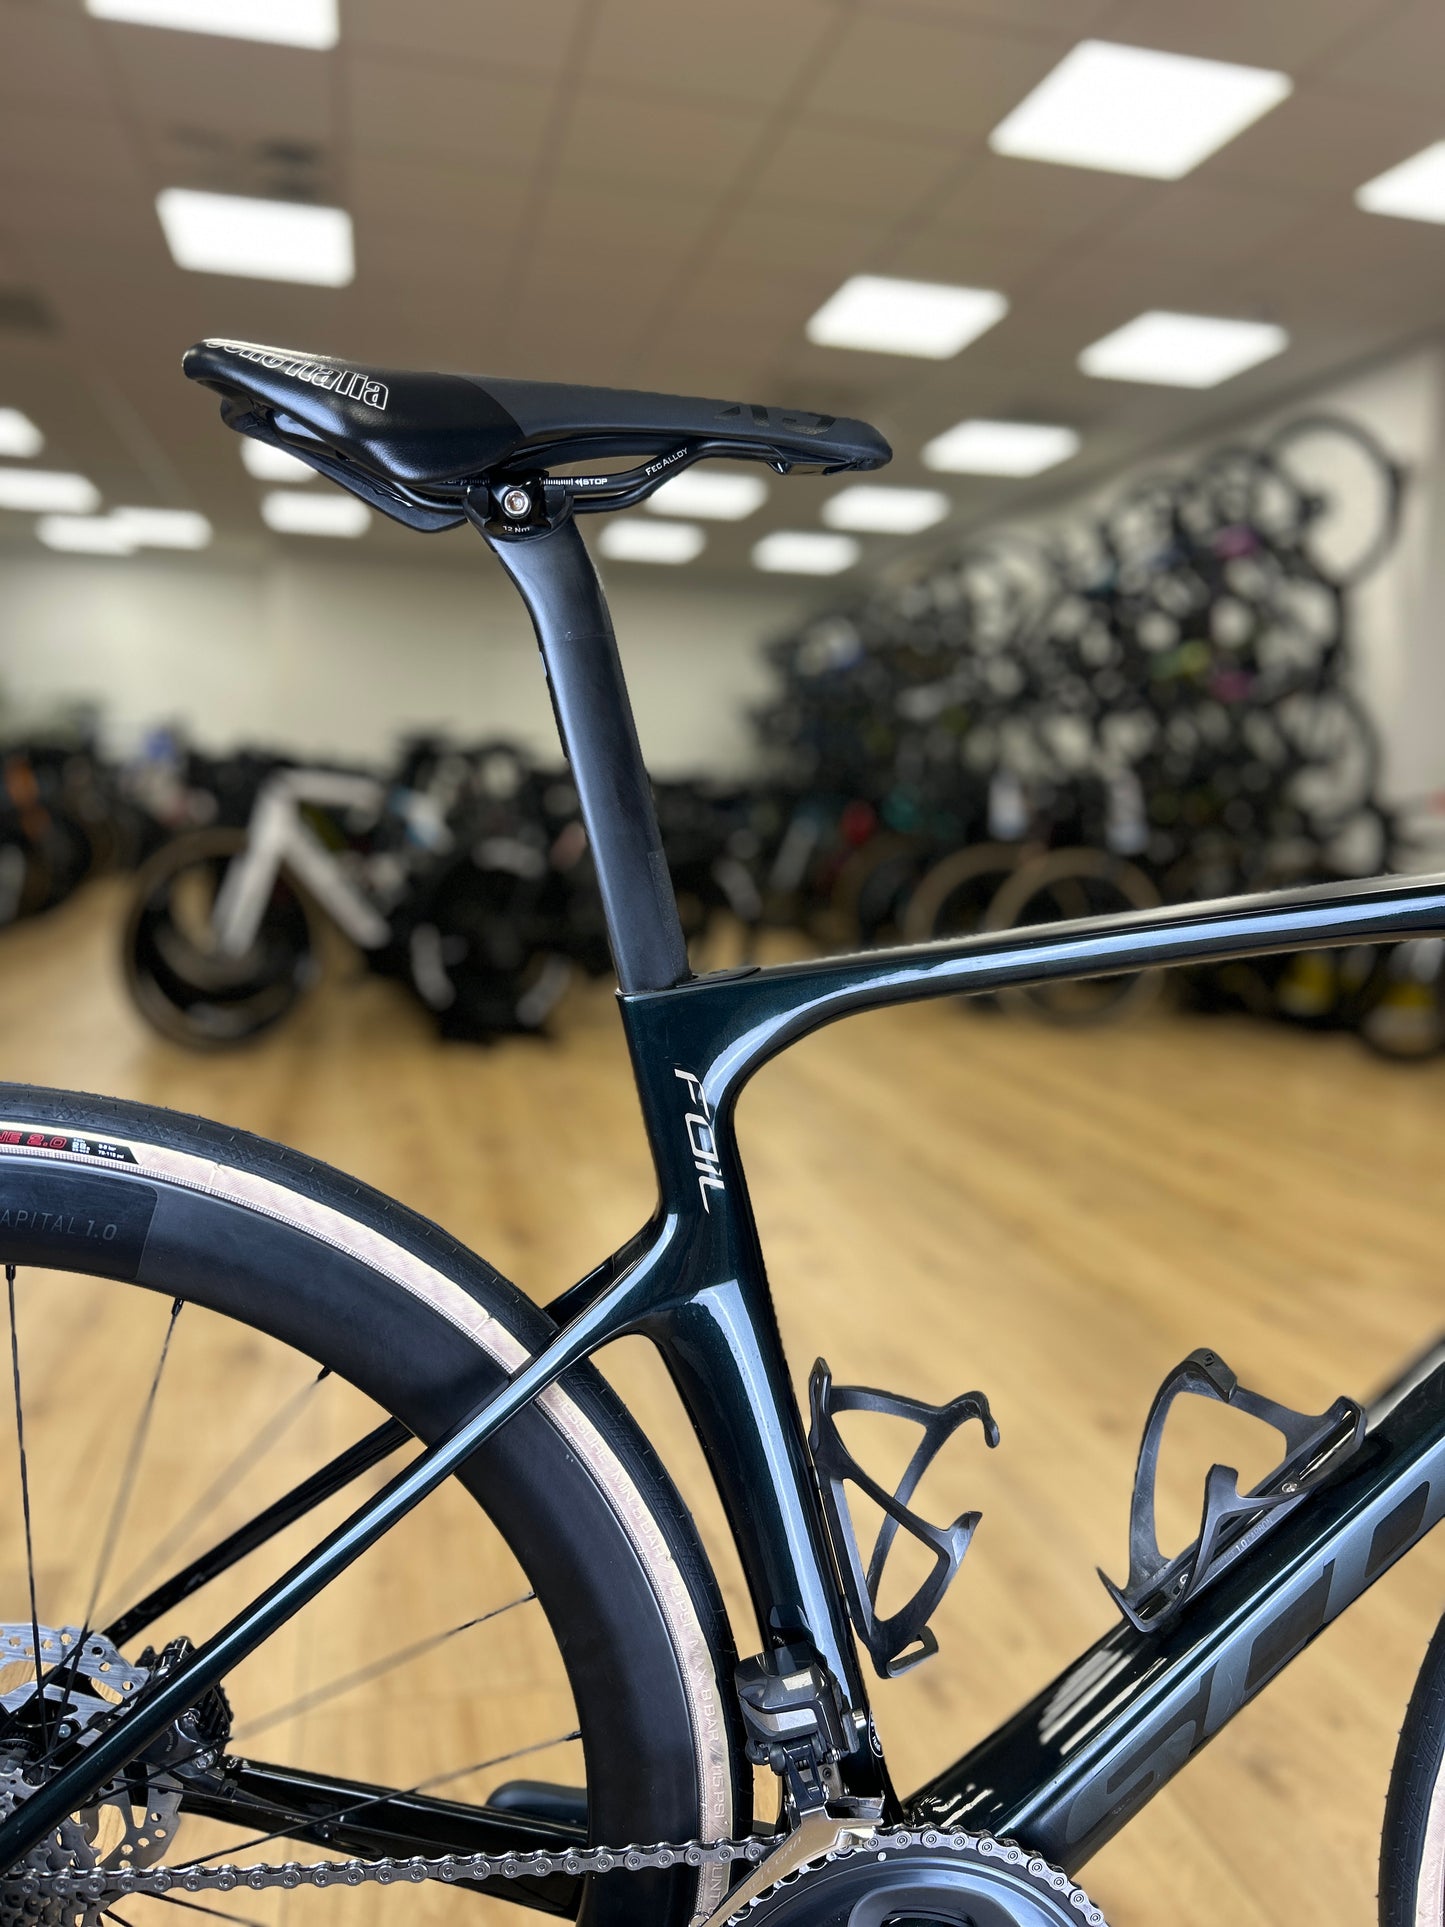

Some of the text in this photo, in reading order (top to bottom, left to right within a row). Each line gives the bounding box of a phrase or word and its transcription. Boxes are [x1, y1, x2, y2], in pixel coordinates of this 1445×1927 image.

[583, 477, 608, 485] STOP
[27, 1135, 67, 1149] 2.0
[674, 1068, 726, 1215] FOIL
[0, 1208, 118, 1241] APITAL 1.0
[1235, 1518, 1273, 1552] 1.0 CARBON
[640, 1521, 665, 1558] BAR
[704, 1704, 719, 1742] BAR
[713, 1791, 725, 1818] PSI
